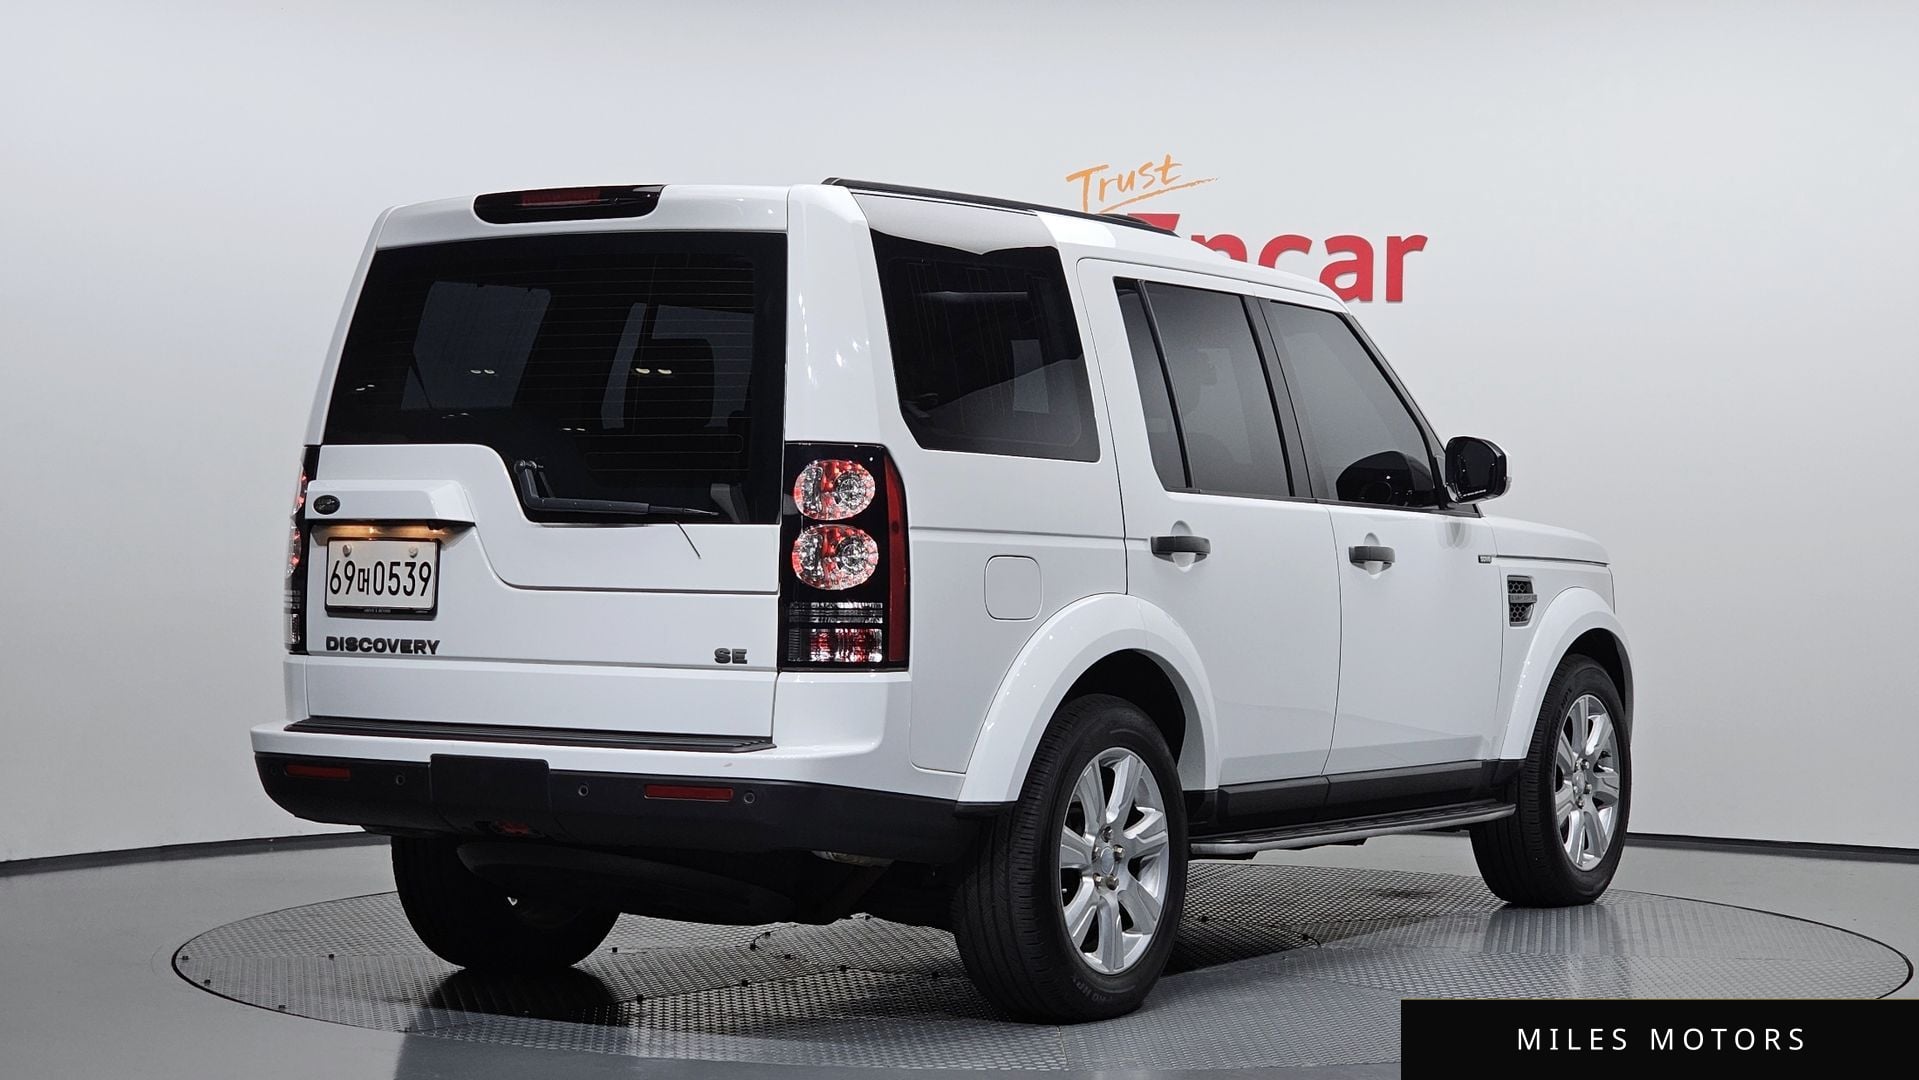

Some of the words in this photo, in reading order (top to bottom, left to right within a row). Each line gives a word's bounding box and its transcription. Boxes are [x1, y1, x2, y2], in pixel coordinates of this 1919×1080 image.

[1065, 153, 1183, 213] Trust
[1128, 213, 1429, 303] car
[329, 560, 432, 597] 69머0539
[325, 636, 441, 655] DISCOVERY
[714, 647, 748, 664] SE
